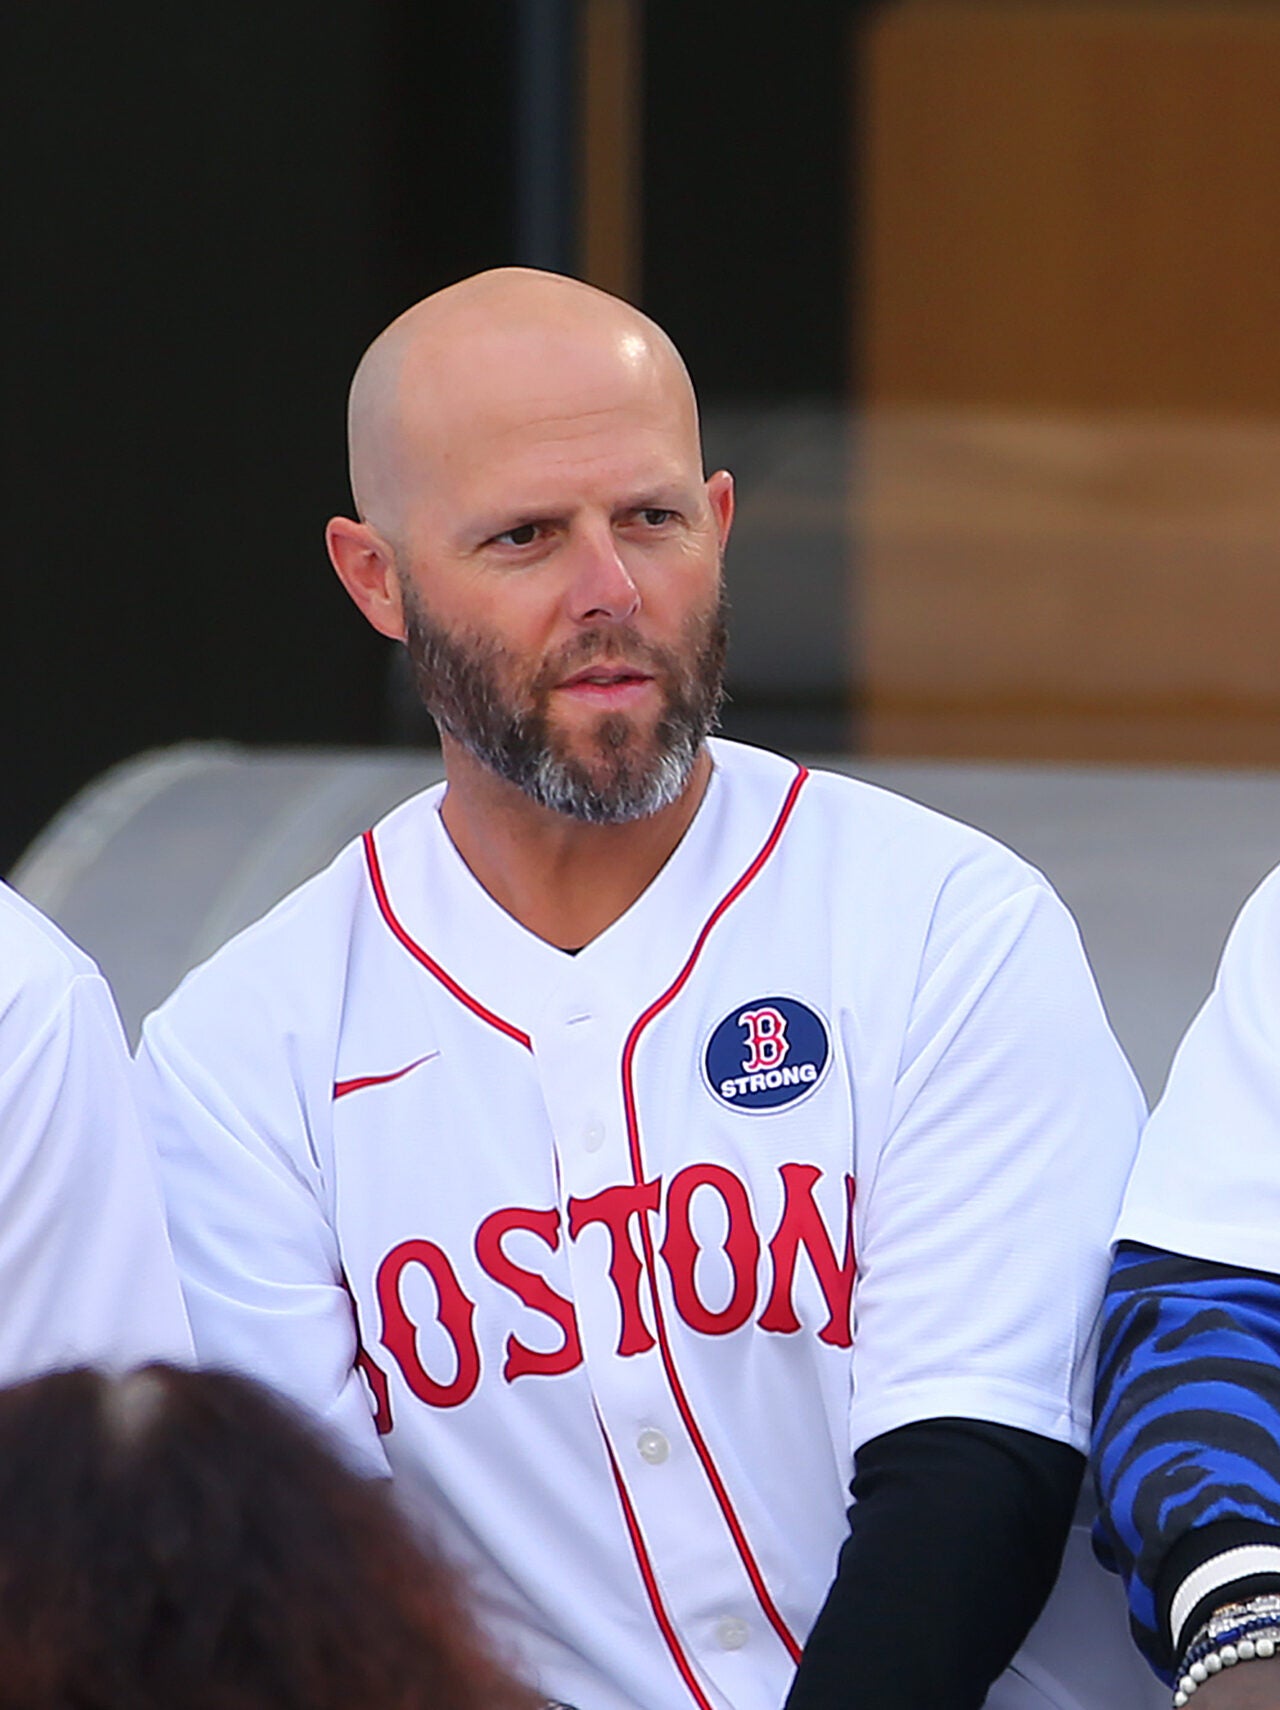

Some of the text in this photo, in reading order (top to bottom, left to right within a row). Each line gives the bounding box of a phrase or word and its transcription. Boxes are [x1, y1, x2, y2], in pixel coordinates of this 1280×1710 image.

[739, 1007, 790, 1073] B
[721, 1063, 818, 1098] STRONG
[345, 1163, 857, 1434] OSTON
